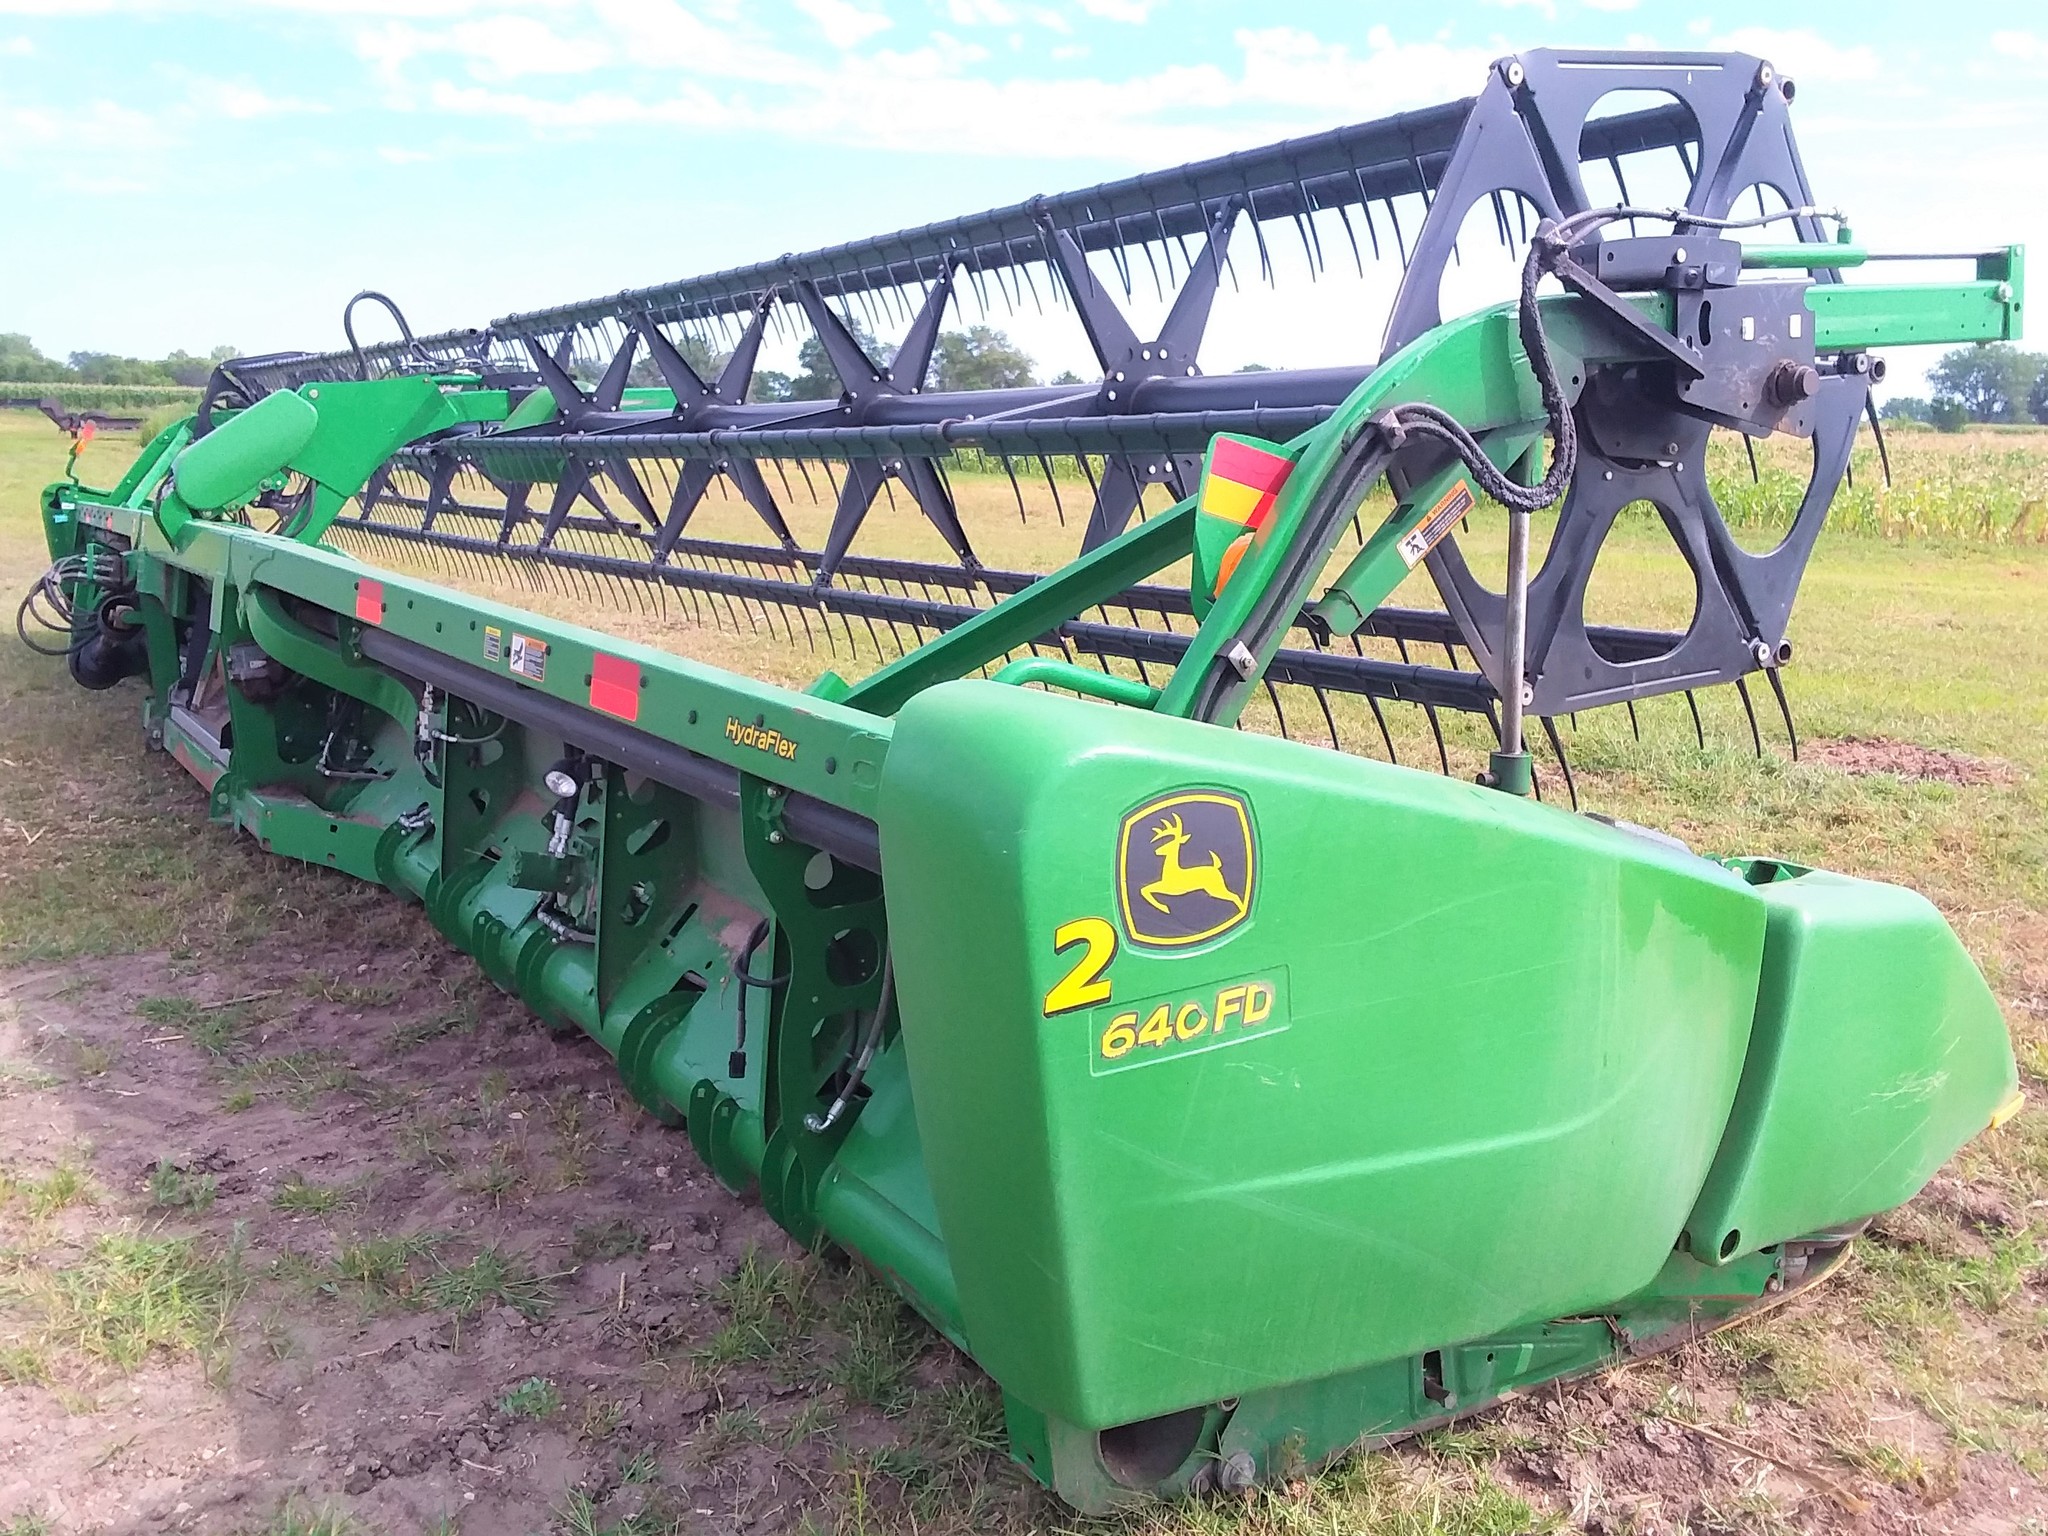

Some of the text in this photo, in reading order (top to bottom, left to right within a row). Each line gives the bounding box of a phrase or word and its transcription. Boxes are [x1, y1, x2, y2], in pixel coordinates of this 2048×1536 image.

[1431, 487, 1459, 515] WARNING
[725, 716, 798, 760] HydraFlex
[1043, 917, 1119, 1018] 2
